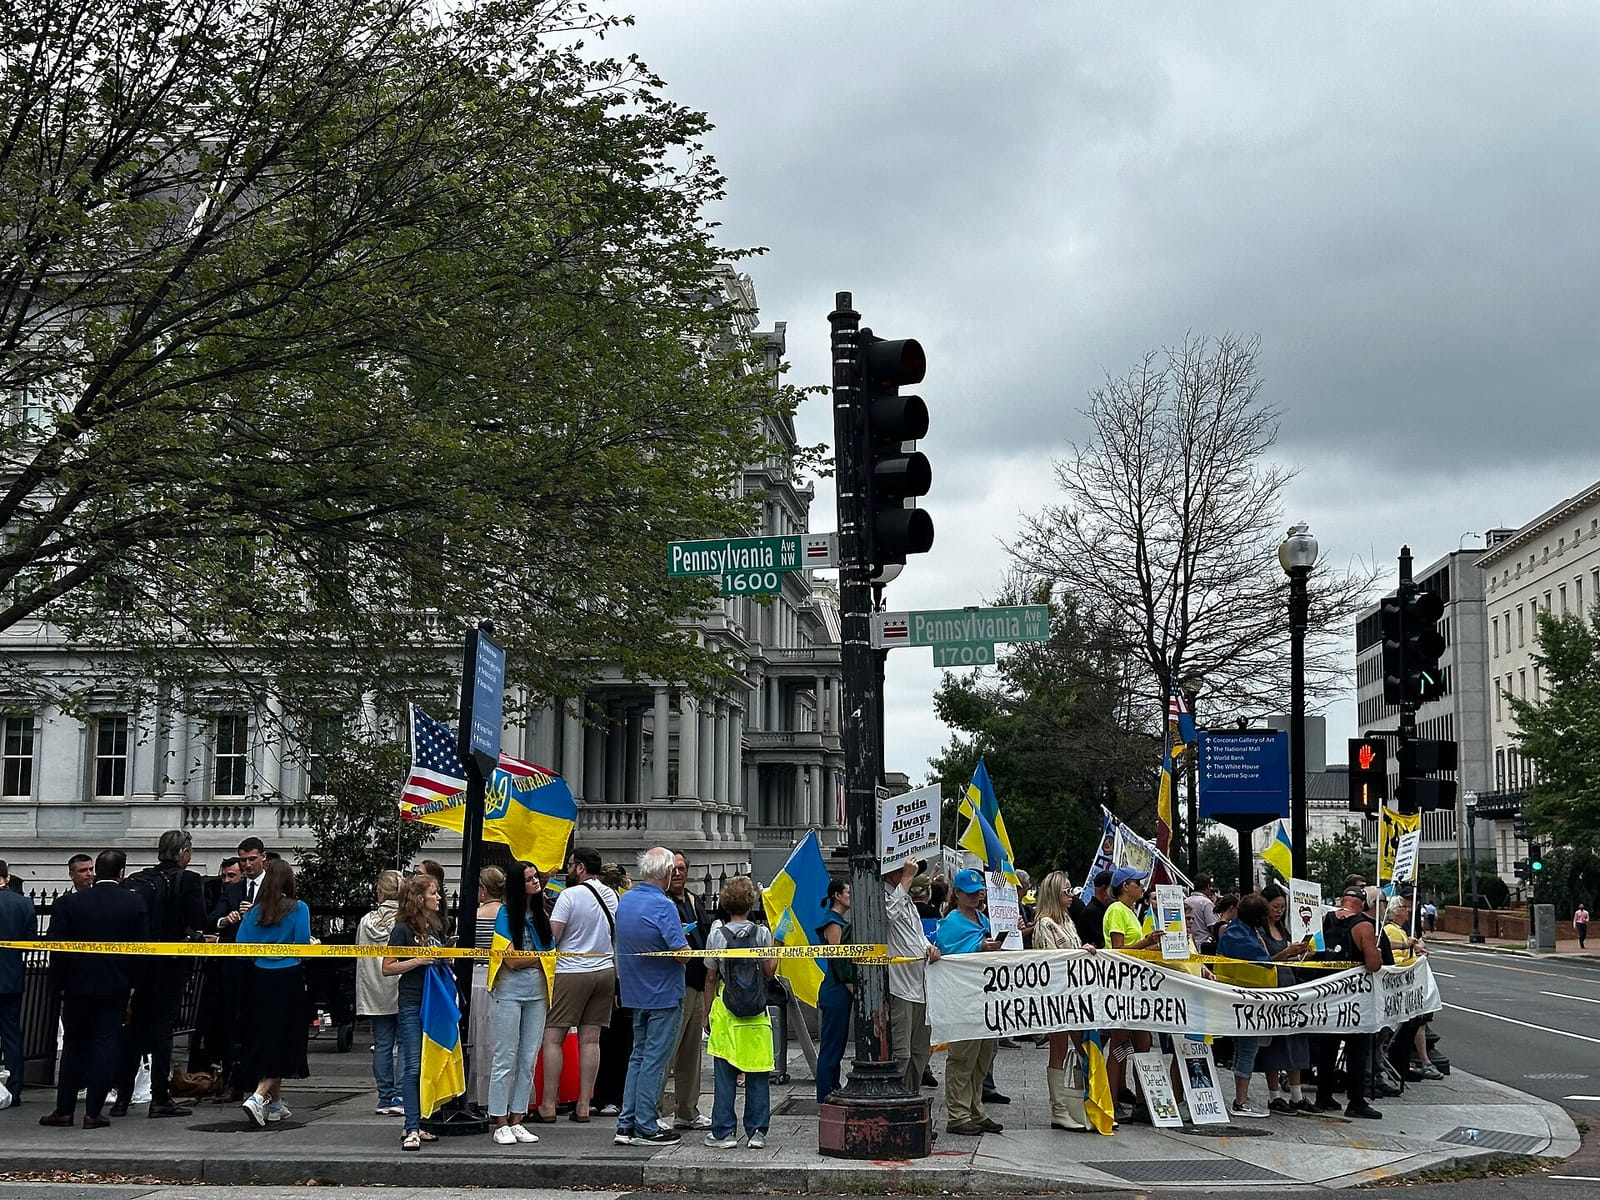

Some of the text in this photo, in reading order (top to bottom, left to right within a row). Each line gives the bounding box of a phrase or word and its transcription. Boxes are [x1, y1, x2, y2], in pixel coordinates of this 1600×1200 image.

[672, 539, 796, 575] Pennsylvania Ave
[781, 552, 796, 566] NW
[725, 572, 778, 591] 1600
[915, 610, 1041, 642] Pennsylvania Ave
[1026, 623, 1039, 637] NW
[939, 646, 989, 665] 1700
[410, 791, 467, 817] STAND WIT
[896, 798, 928, 816] Putin
[891, 811, 931, 833] Always
[897, 826, 925, 844] Lies!
[882, 850, 910, 865] Support
[982, 960, 1050, 994] 20,000
[1066, 959, 1166, 992] KIDNAPPED
[984, 994, 1188, 1035] UKRAINIAN CHILDREN
[1336, 1002, 1361, 1027] HIS
[1191, 1043, 1209, 1055] STAND
[1195, 1091, 1213, 1102] WITH
